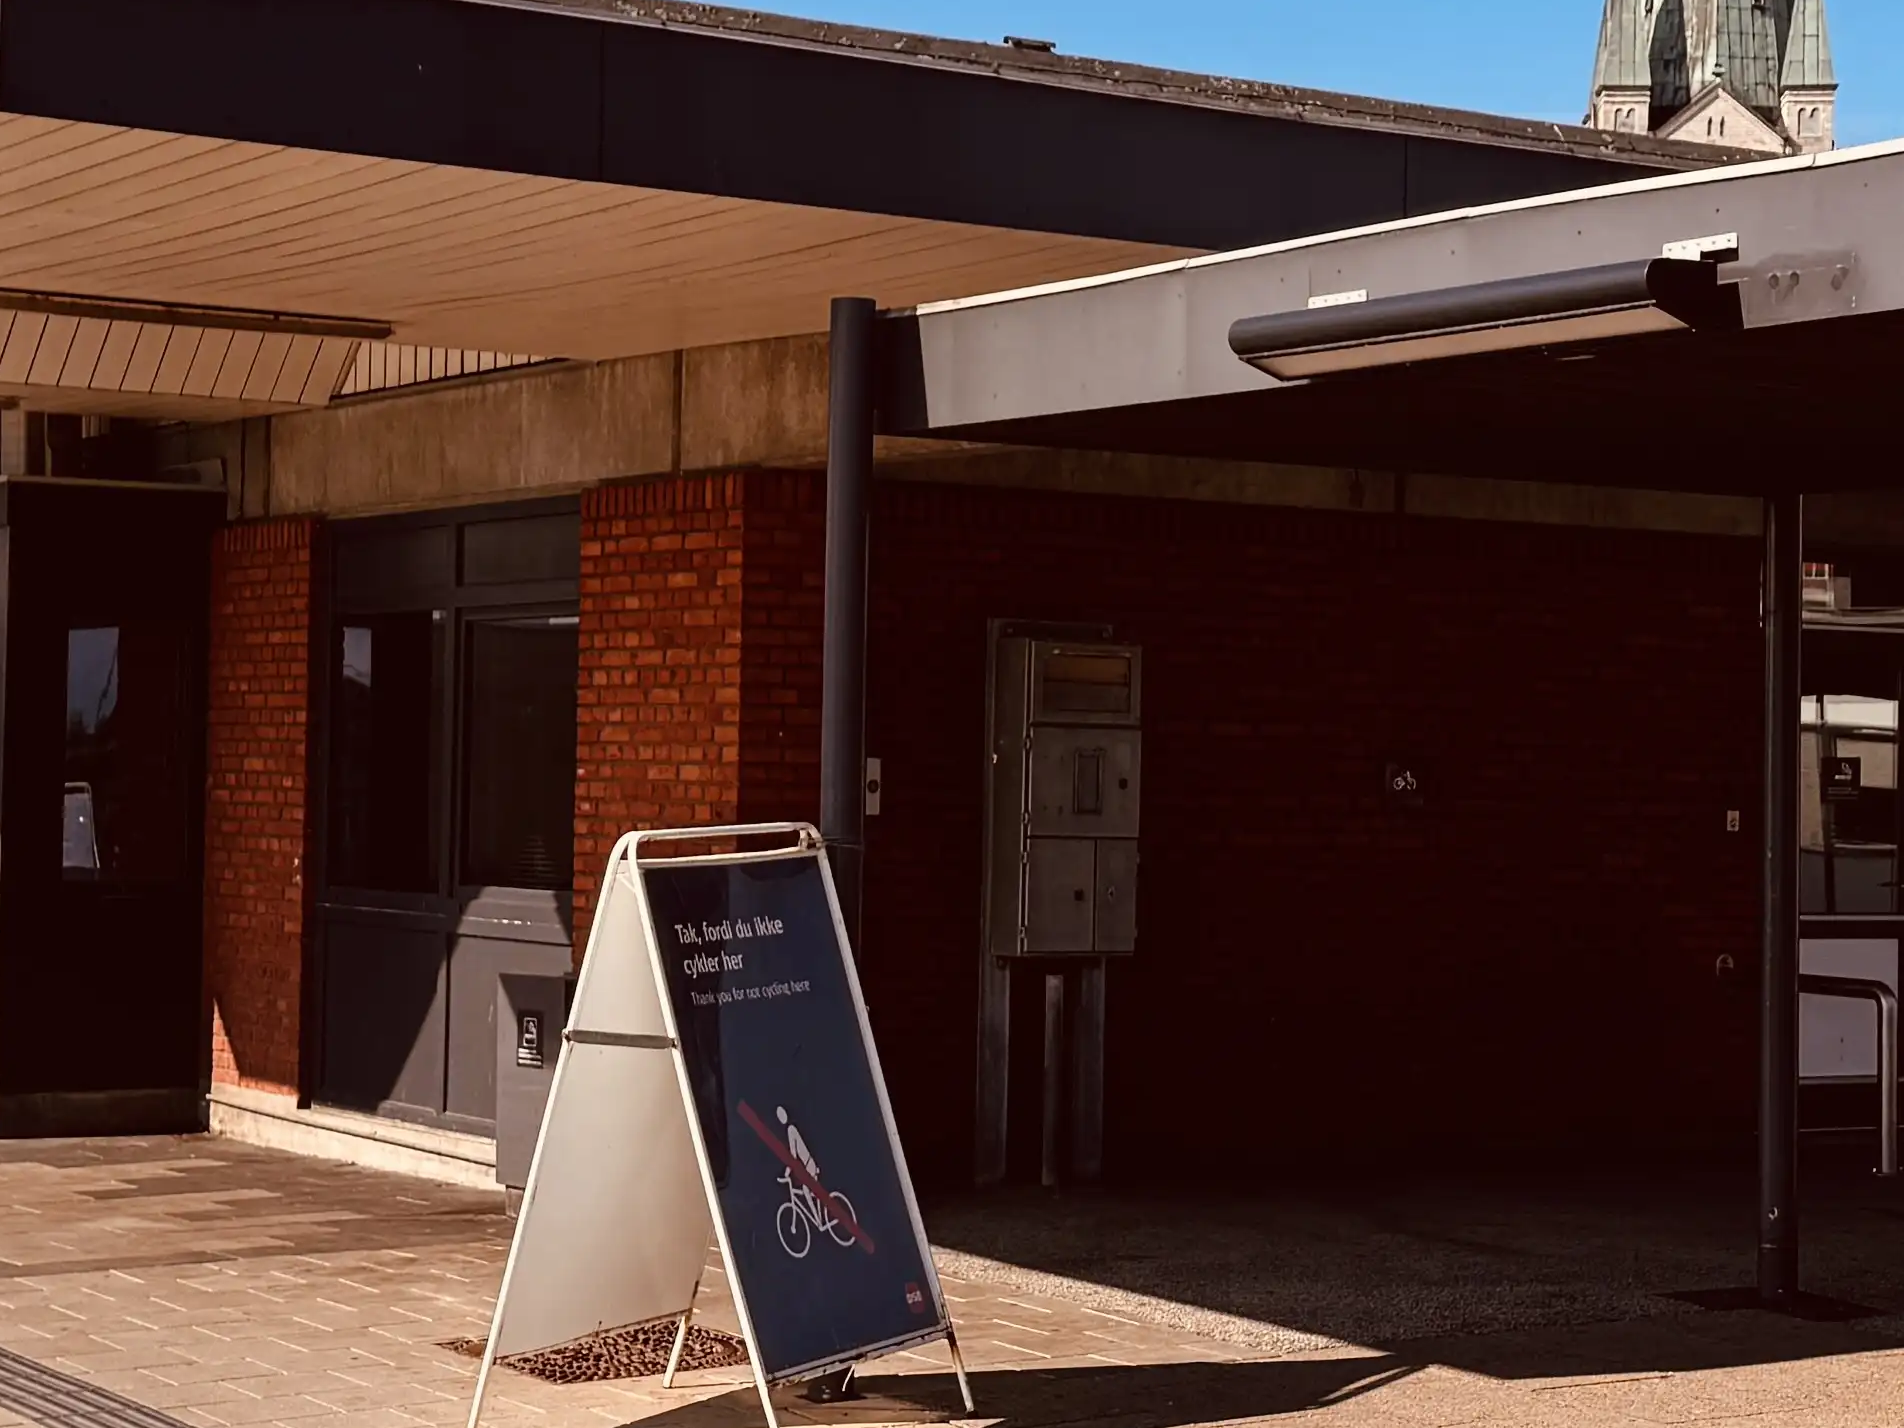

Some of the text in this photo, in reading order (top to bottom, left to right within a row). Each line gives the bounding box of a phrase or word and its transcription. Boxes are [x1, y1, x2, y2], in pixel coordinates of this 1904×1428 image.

[674, 915, 784, 946] Tak, fordi du ikke
[683, 950, 743, 979] cykler her
[691, 979, 811, 1007] Thank you for not cycling here
